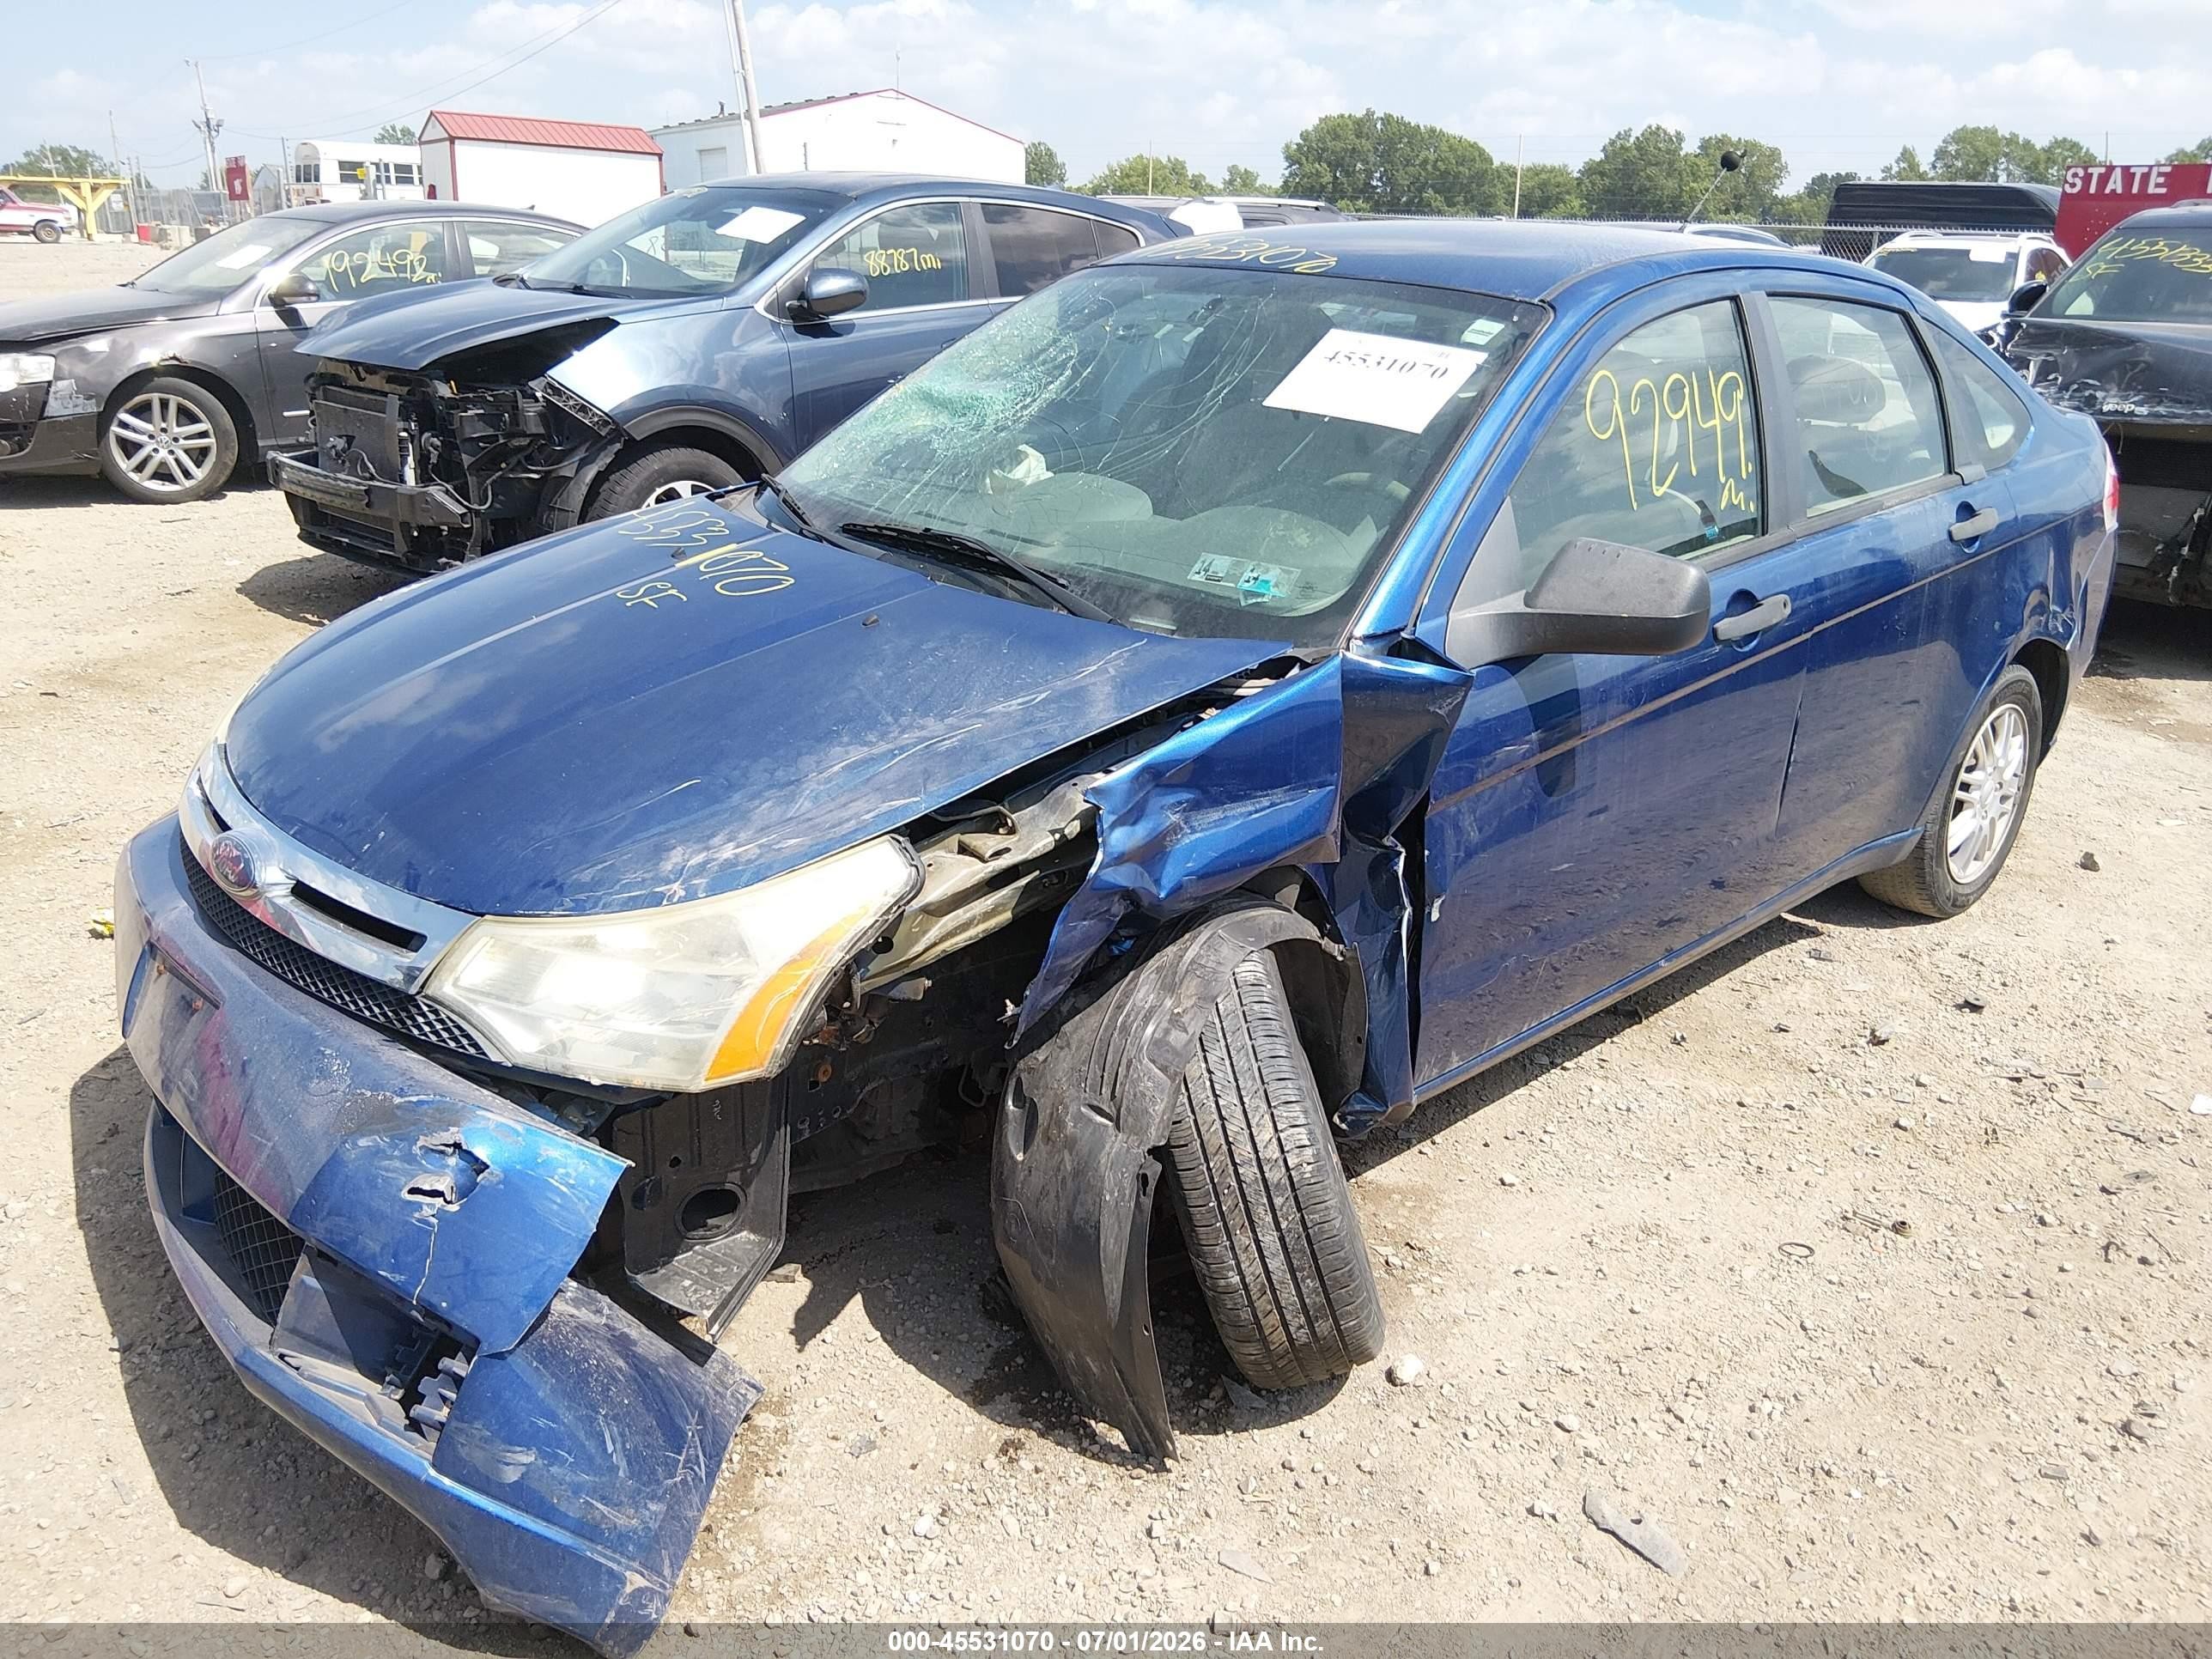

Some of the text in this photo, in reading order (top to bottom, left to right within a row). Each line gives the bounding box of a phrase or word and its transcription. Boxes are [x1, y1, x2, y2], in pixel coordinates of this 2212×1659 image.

[2064, 167, 2172, 194] STATE
[326, 249, 427, 292] 192492
[2069, 262, 2125, 280] SF
[1586, 367, 1747, 511] 92949
[616, 581, 687, 609] SF
